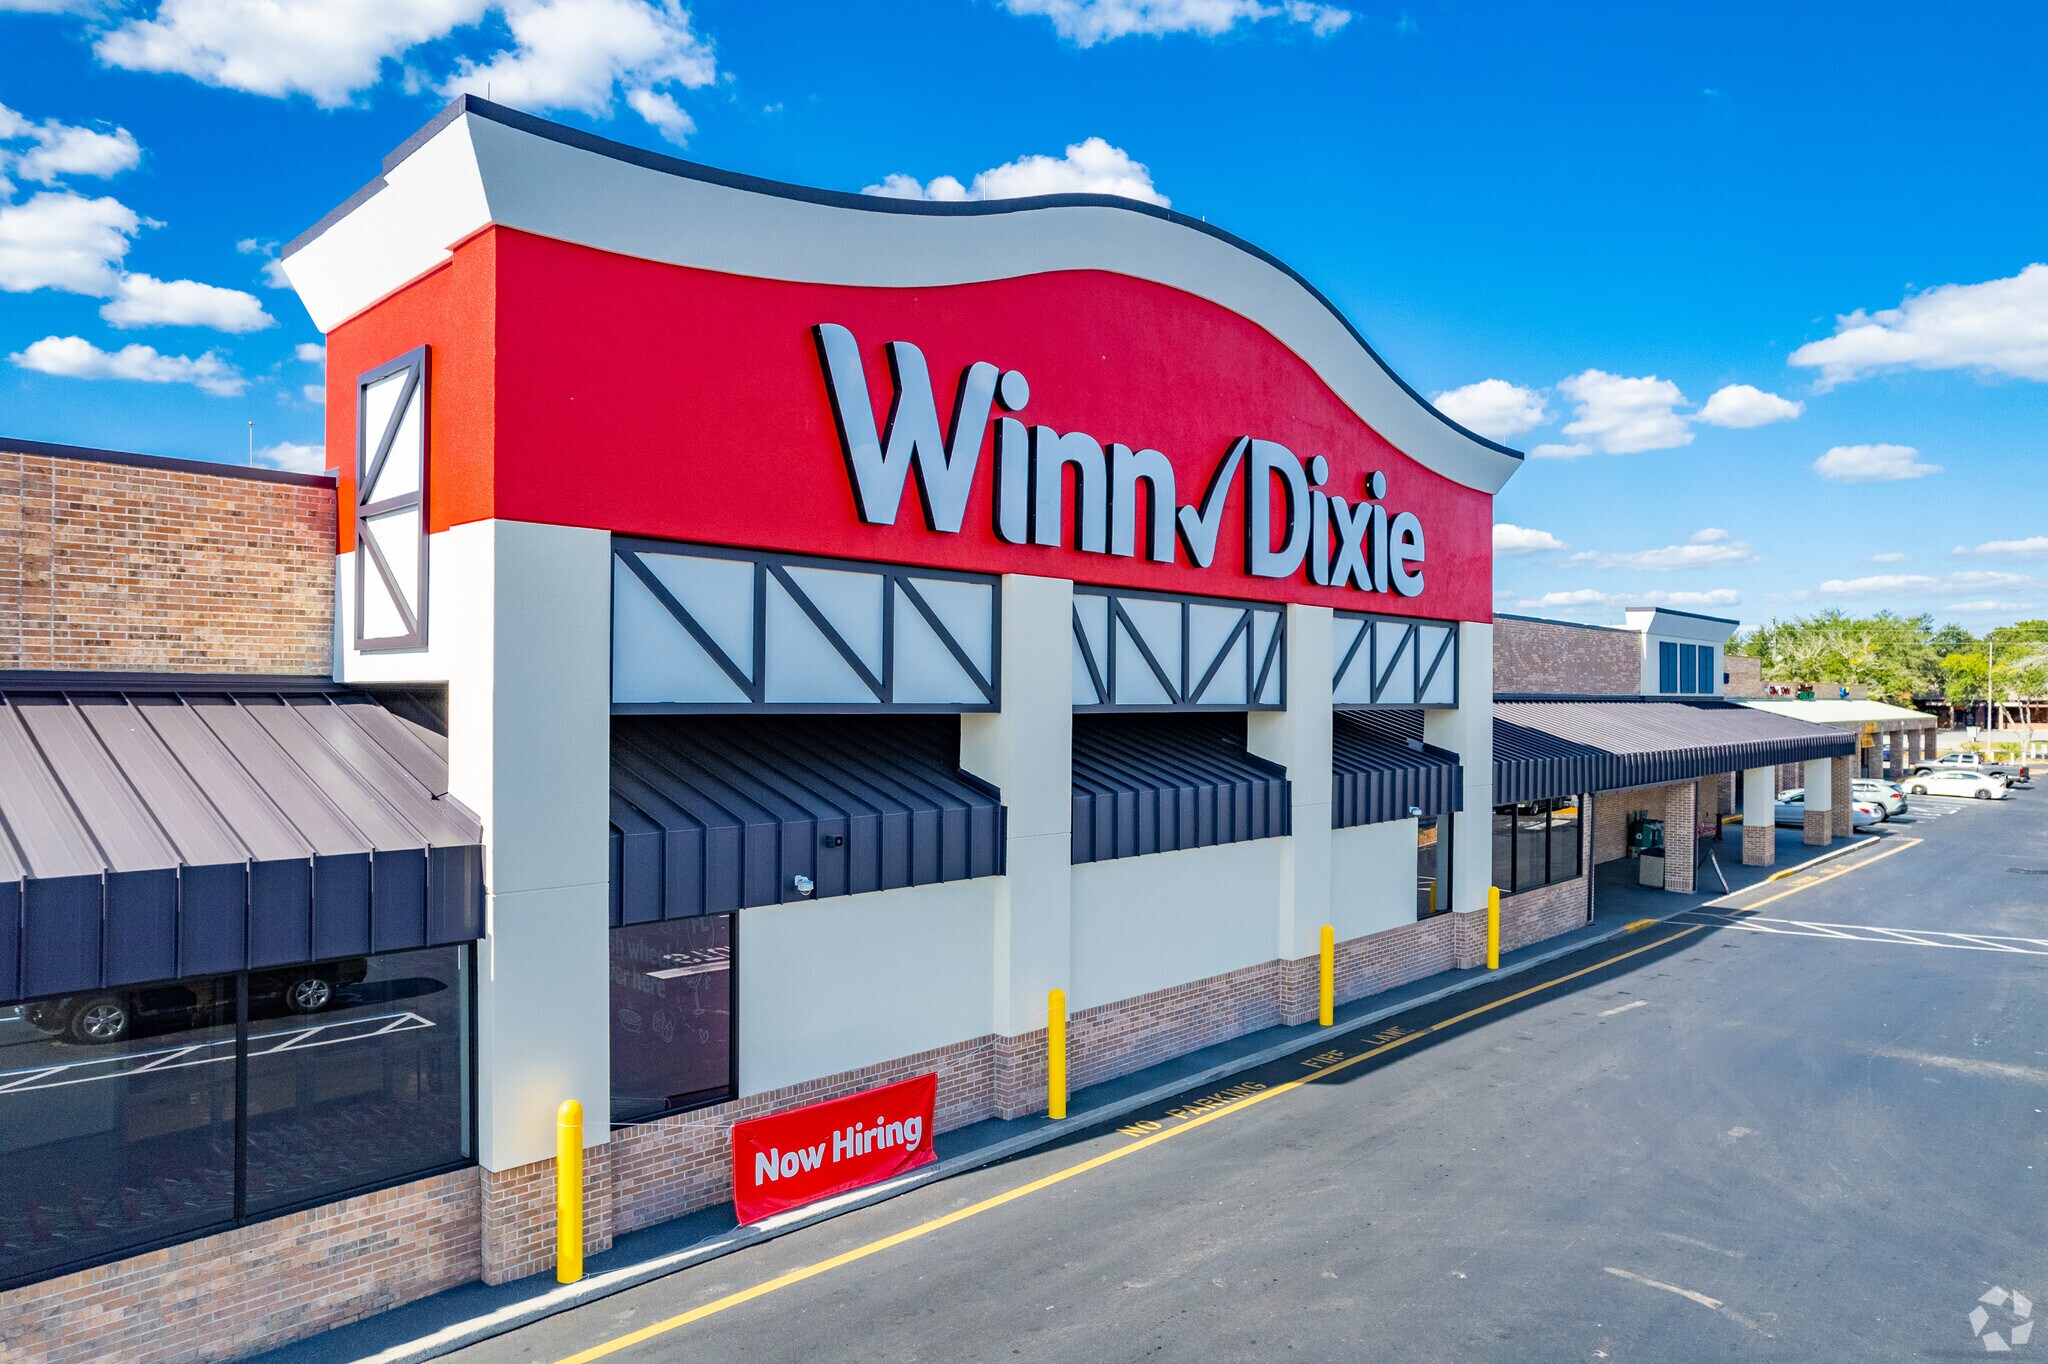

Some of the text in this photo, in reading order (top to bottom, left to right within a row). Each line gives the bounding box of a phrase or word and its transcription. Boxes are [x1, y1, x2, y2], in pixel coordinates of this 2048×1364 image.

[811, 322, 1425, 597] Winn Dixie
[1115, 1119, 1162, 1138] NO
[1164, 1081, 1267, 1120] PARKING
[755, 1115, 923, 1187] Now Hiring
